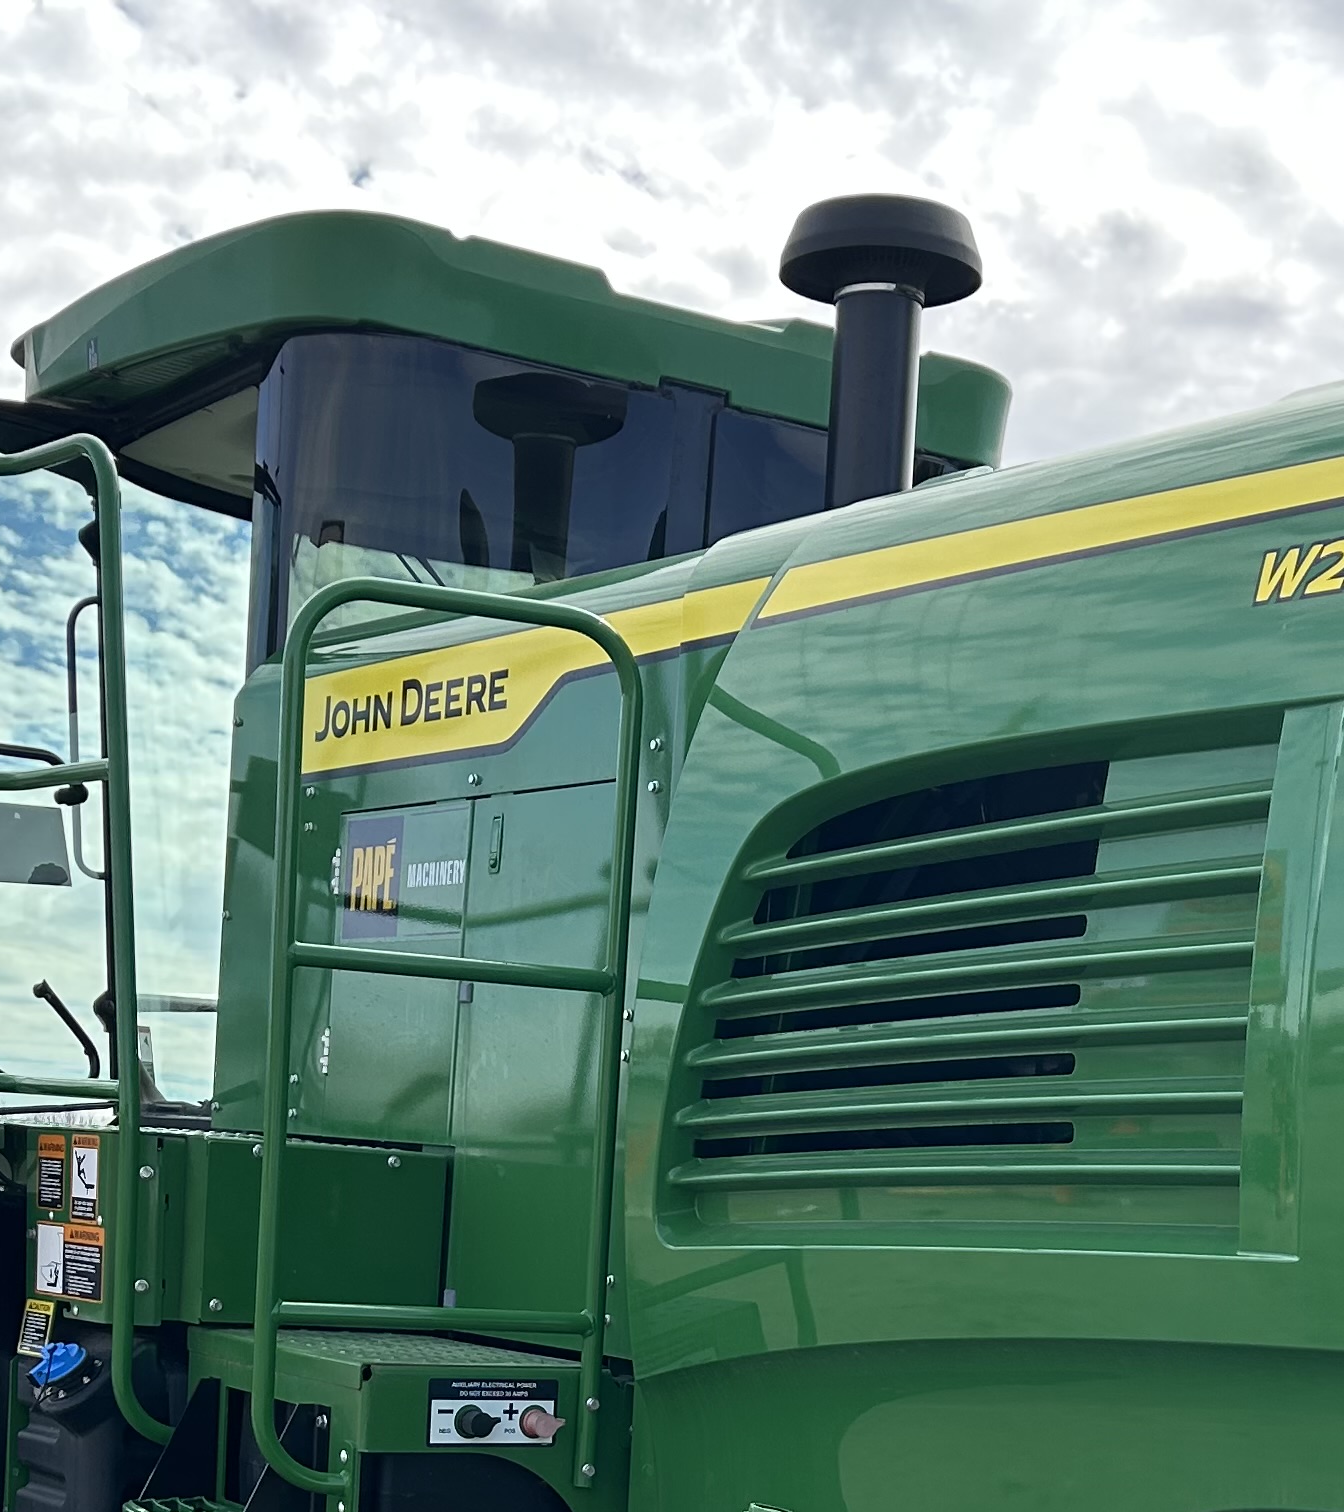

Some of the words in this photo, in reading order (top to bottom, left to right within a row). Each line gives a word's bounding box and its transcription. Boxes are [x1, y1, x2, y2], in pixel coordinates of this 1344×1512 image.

[315, 691, 393, 742] JOHN
[400, 669, 509, 727] DEERE
[406, 858, 466, 888] MACHINERY
